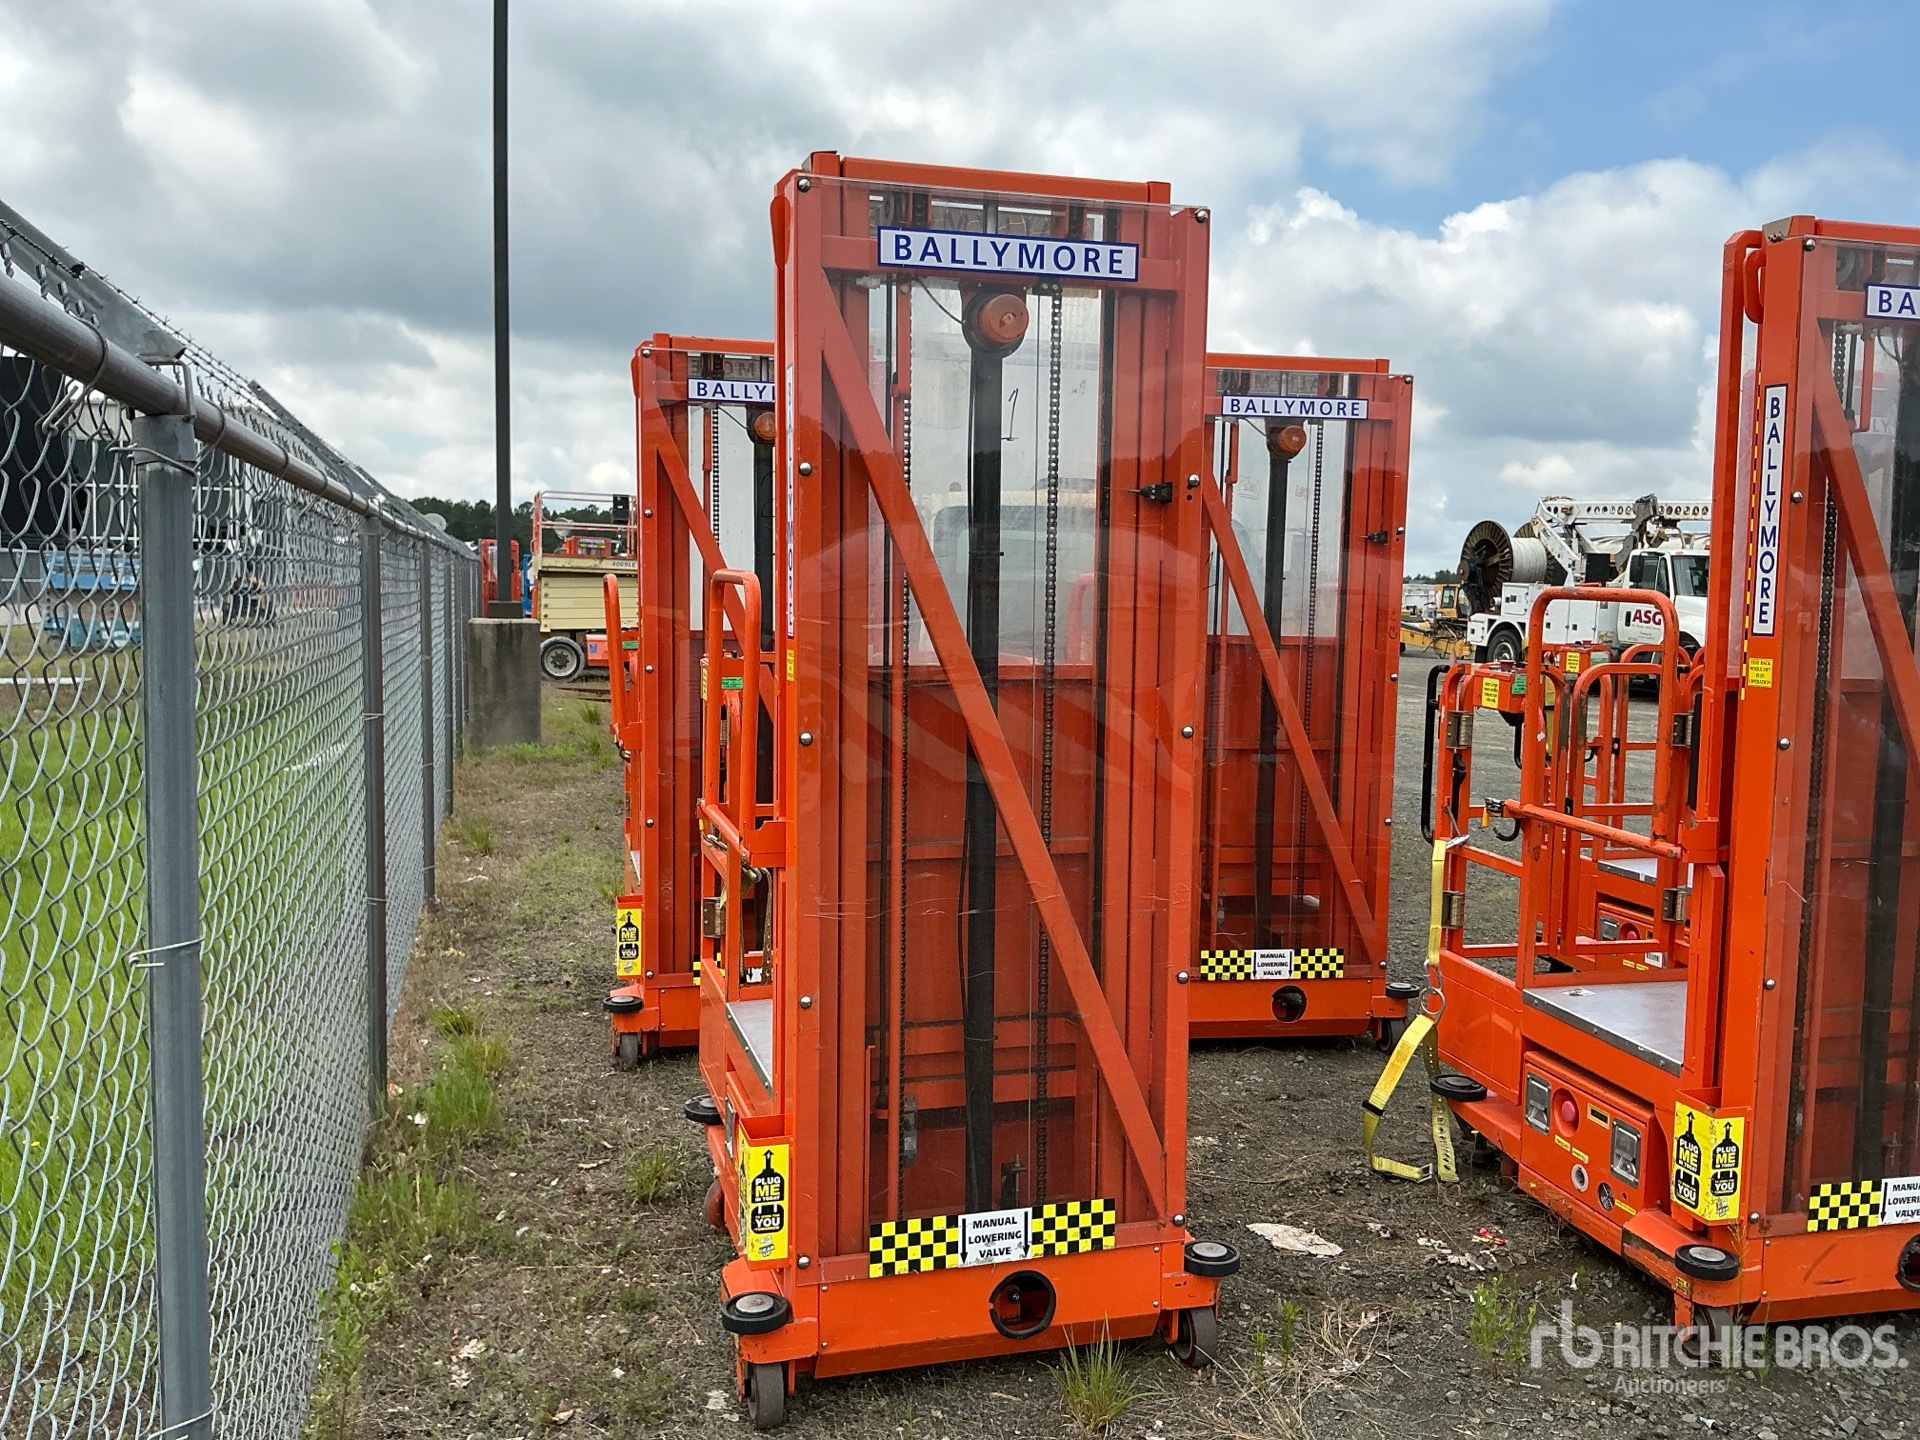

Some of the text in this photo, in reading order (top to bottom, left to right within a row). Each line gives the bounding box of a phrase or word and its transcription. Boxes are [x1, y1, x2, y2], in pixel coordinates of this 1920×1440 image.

[895, 233, 1124, 275] BALLYMORE
[696, 381, 775, 400] BALLY
[1230, 398, 1360, 417] BALLYMORE
[1758, 396, 1781, 625] BALLYMORE
[1632, 608, 1663, 626] ASG
[621, 931, 637, 939] ME
[1679, 1138, 1699, 1154] PLUG
[1716, 1145, 1737, 1153] PLUG
[1679, 1146, 1699, 1168] ME
[1716, 1152, 1736, 1164] ME
[755, 1176, 781, 1186] PLUG
[1714, 1181, 1735, 1191] YOU
[755, 1184, 780, 1198] ME
[1677, 1183, 1696, 1201] YOU
[755, 1217, 780, 1228] YOU
[973, 1216, 1018, 1229] MANUAL
[968, 1230, 1022, 1245] LOWERING
[979, 1246, 1012, 1258] VALVE
